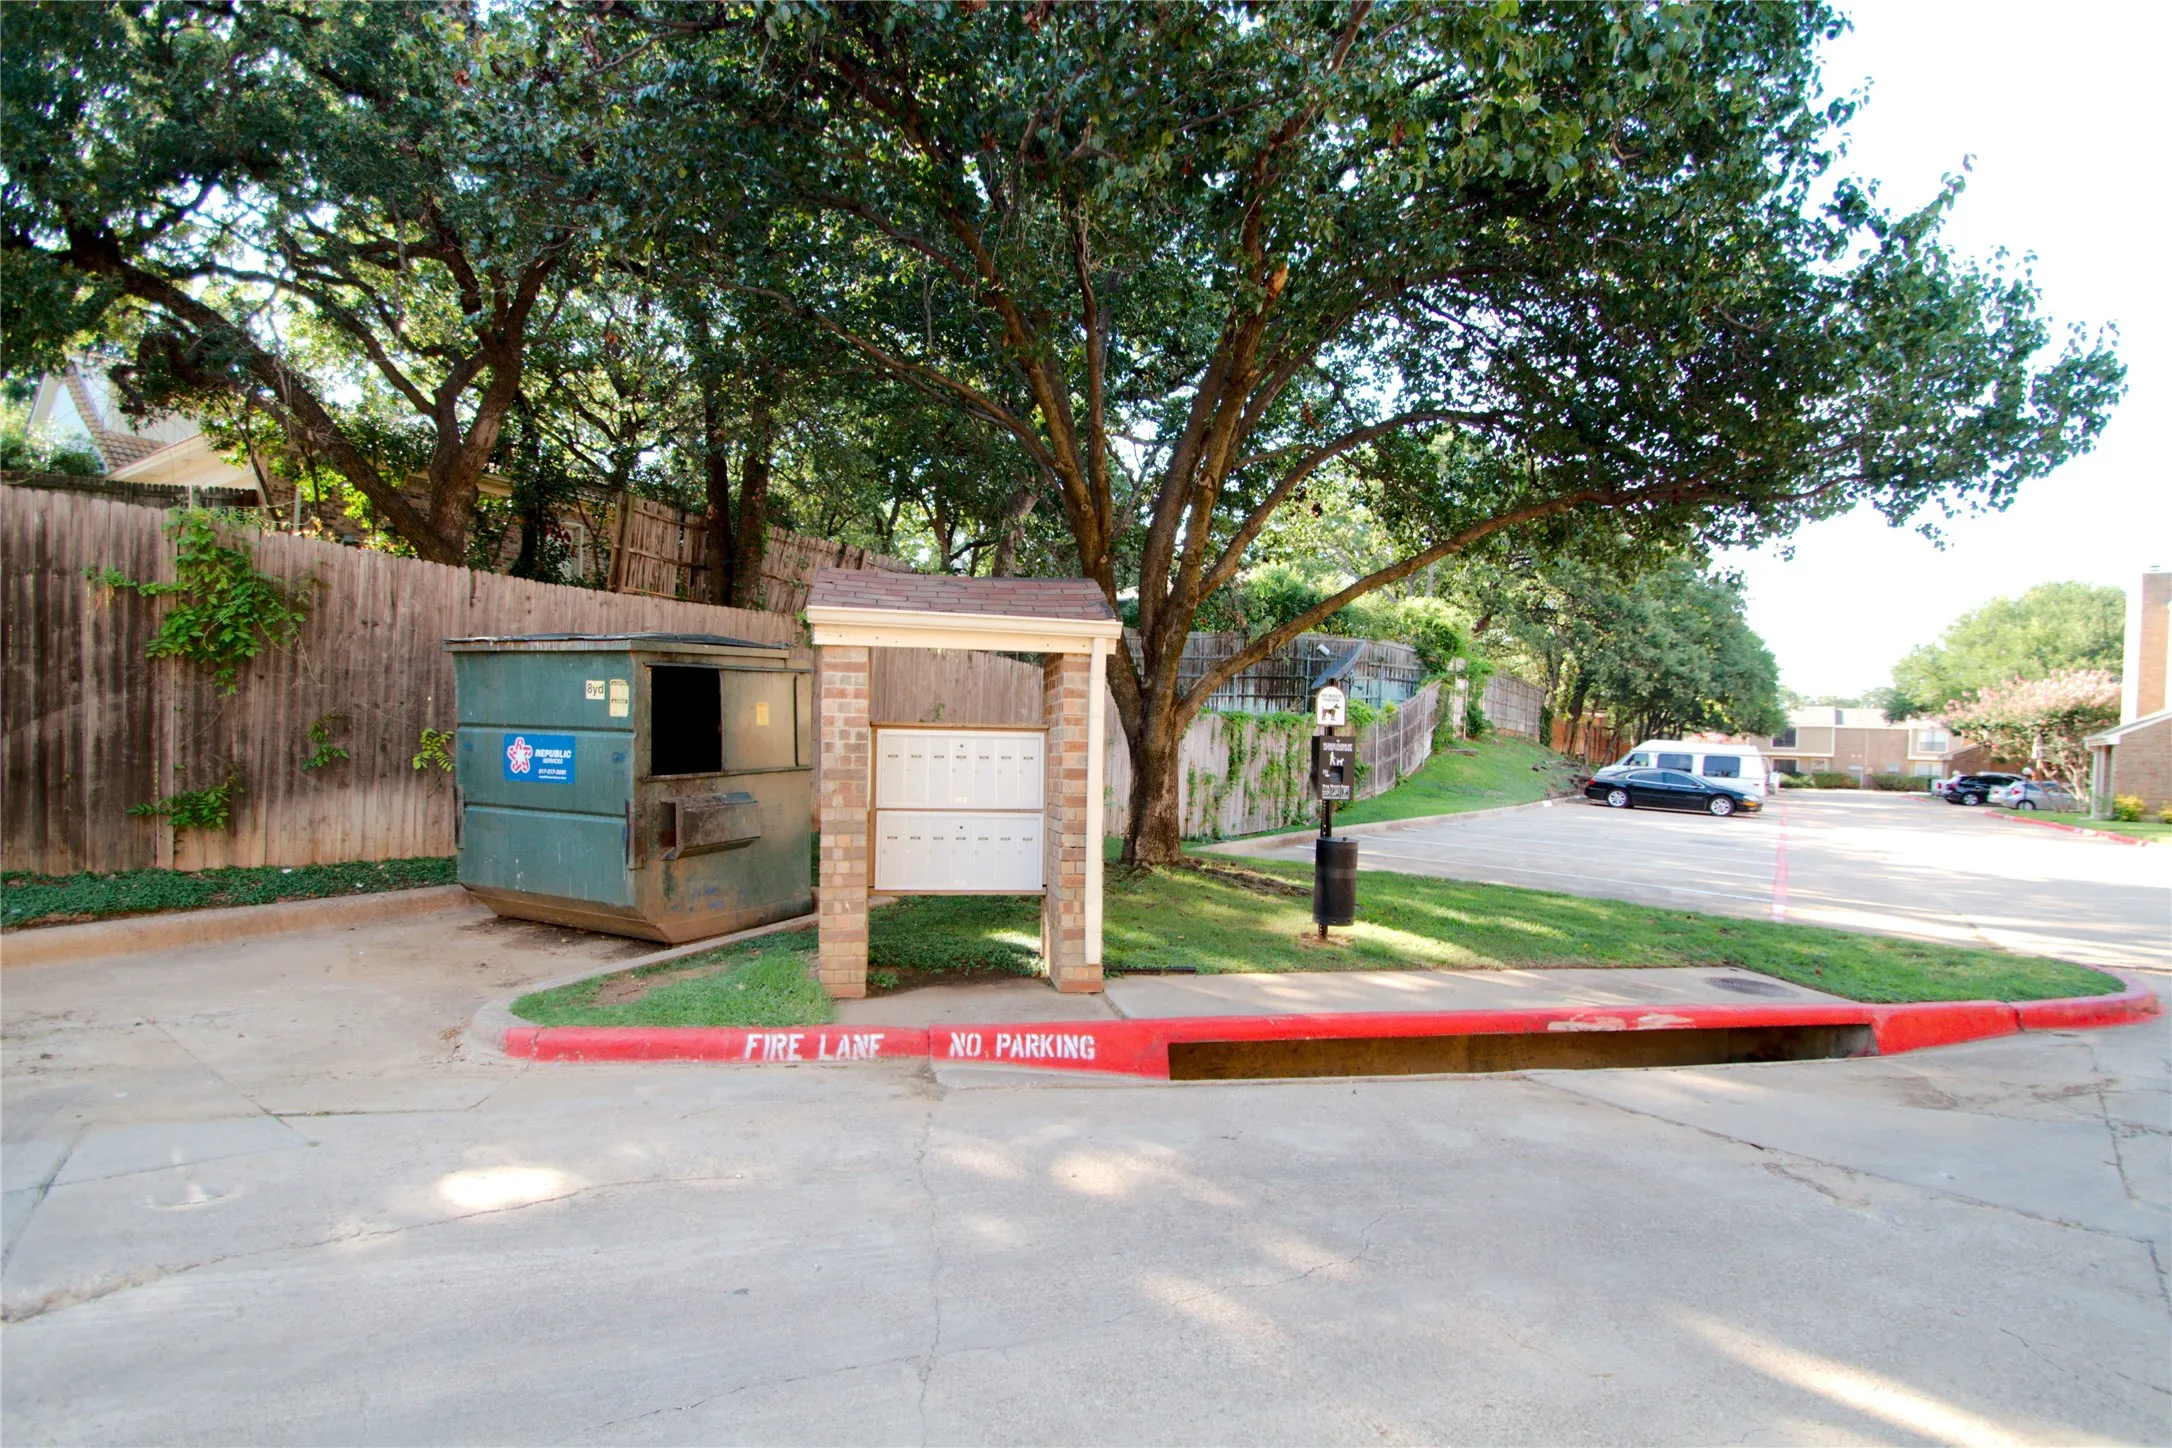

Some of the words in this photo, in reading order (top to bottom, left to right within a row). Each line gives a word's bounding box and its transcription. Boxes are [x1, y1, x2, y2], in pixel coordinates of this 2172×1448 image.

[588, 683, 604, 696] 8yd
[535, 749, 572, 759] REPUBLIC
[744, 1033, 804, 1061] FIRE
[950, 1032, 982, 1057] NO
[996, 1033, 1096, 1060] PARKING
